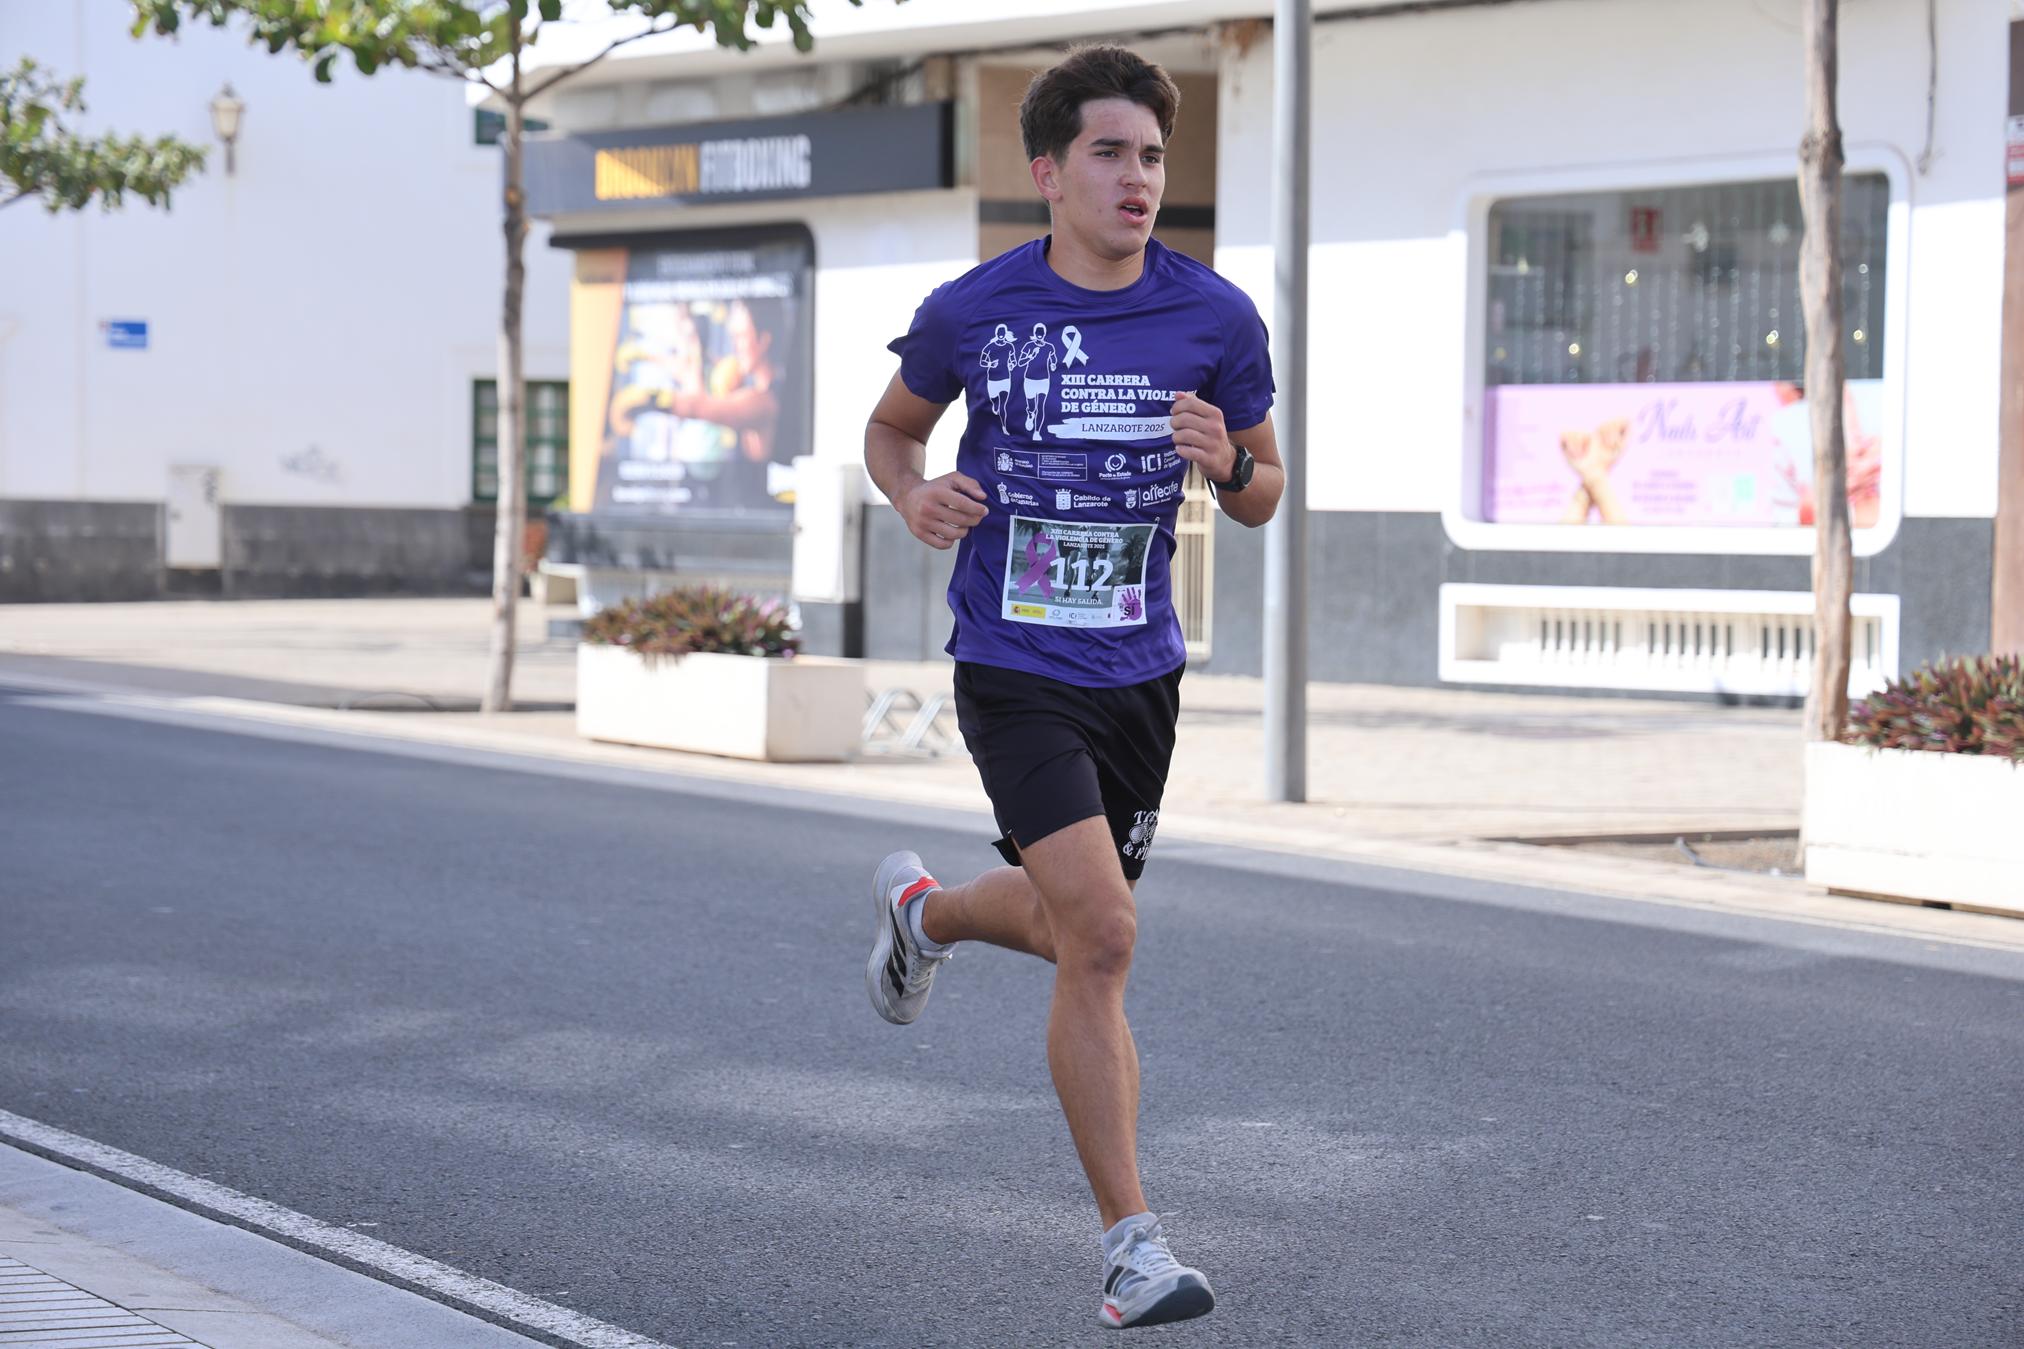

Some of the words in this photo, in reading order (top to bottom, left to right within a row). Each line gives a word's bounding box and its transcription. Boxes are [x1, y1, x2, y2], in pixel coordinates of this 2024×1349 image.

[1061, 374, 1086, 385] XIII
[1087, 375, 1151, 386] CARRERA
[1061, 388, 1117, 400] CONTRA
[1117, 389, 1137, 400] LA
[1138, 389, 1178, 401] VIOLE
[1061, 402, 1080, 413] DE
[1081, 399, 1137, 414] GÉNERO
[1081, 423, 1143, 433] LANZAROTE
[1144, 423, 1165, 433] 2025
[1073, 494, 1101, 502] Cabildo
[1050, 557, 1114, 591] 112
